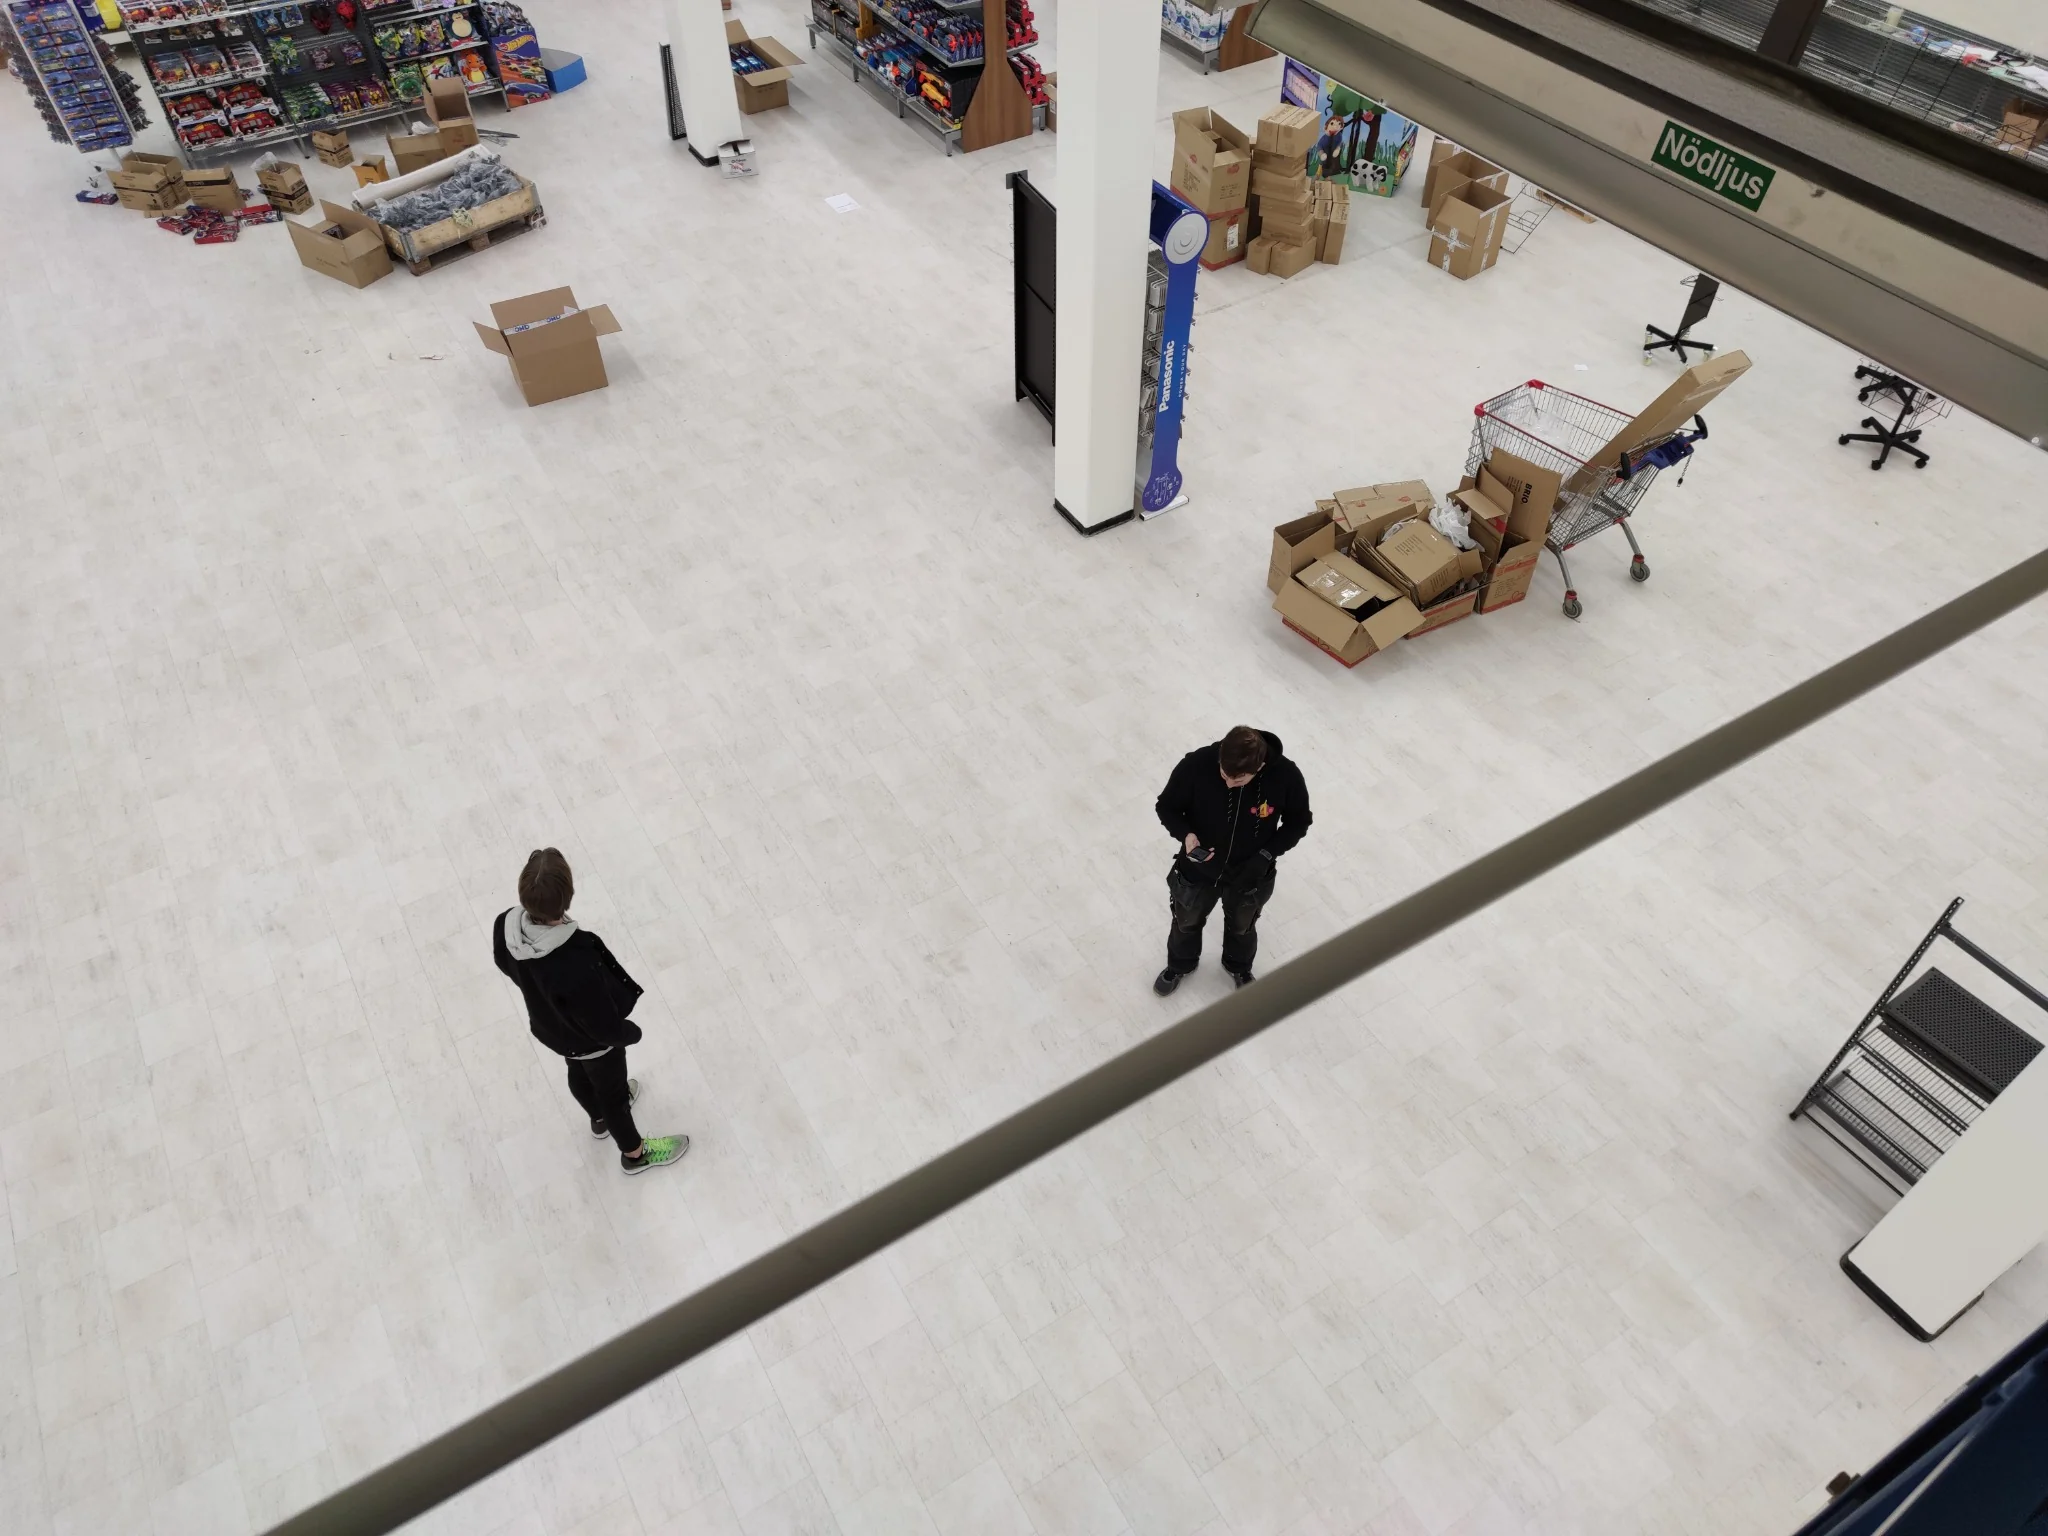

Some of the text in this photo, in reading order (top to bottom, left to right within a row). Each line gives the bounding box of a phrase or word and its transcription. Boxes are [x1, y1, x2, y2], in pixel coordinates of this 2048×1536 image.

[1660, 128, 1764, 200] Nödljus
[1158, 340, 1175, 413] Panasonic
[1521, 483, 1532, 503] BRIO
